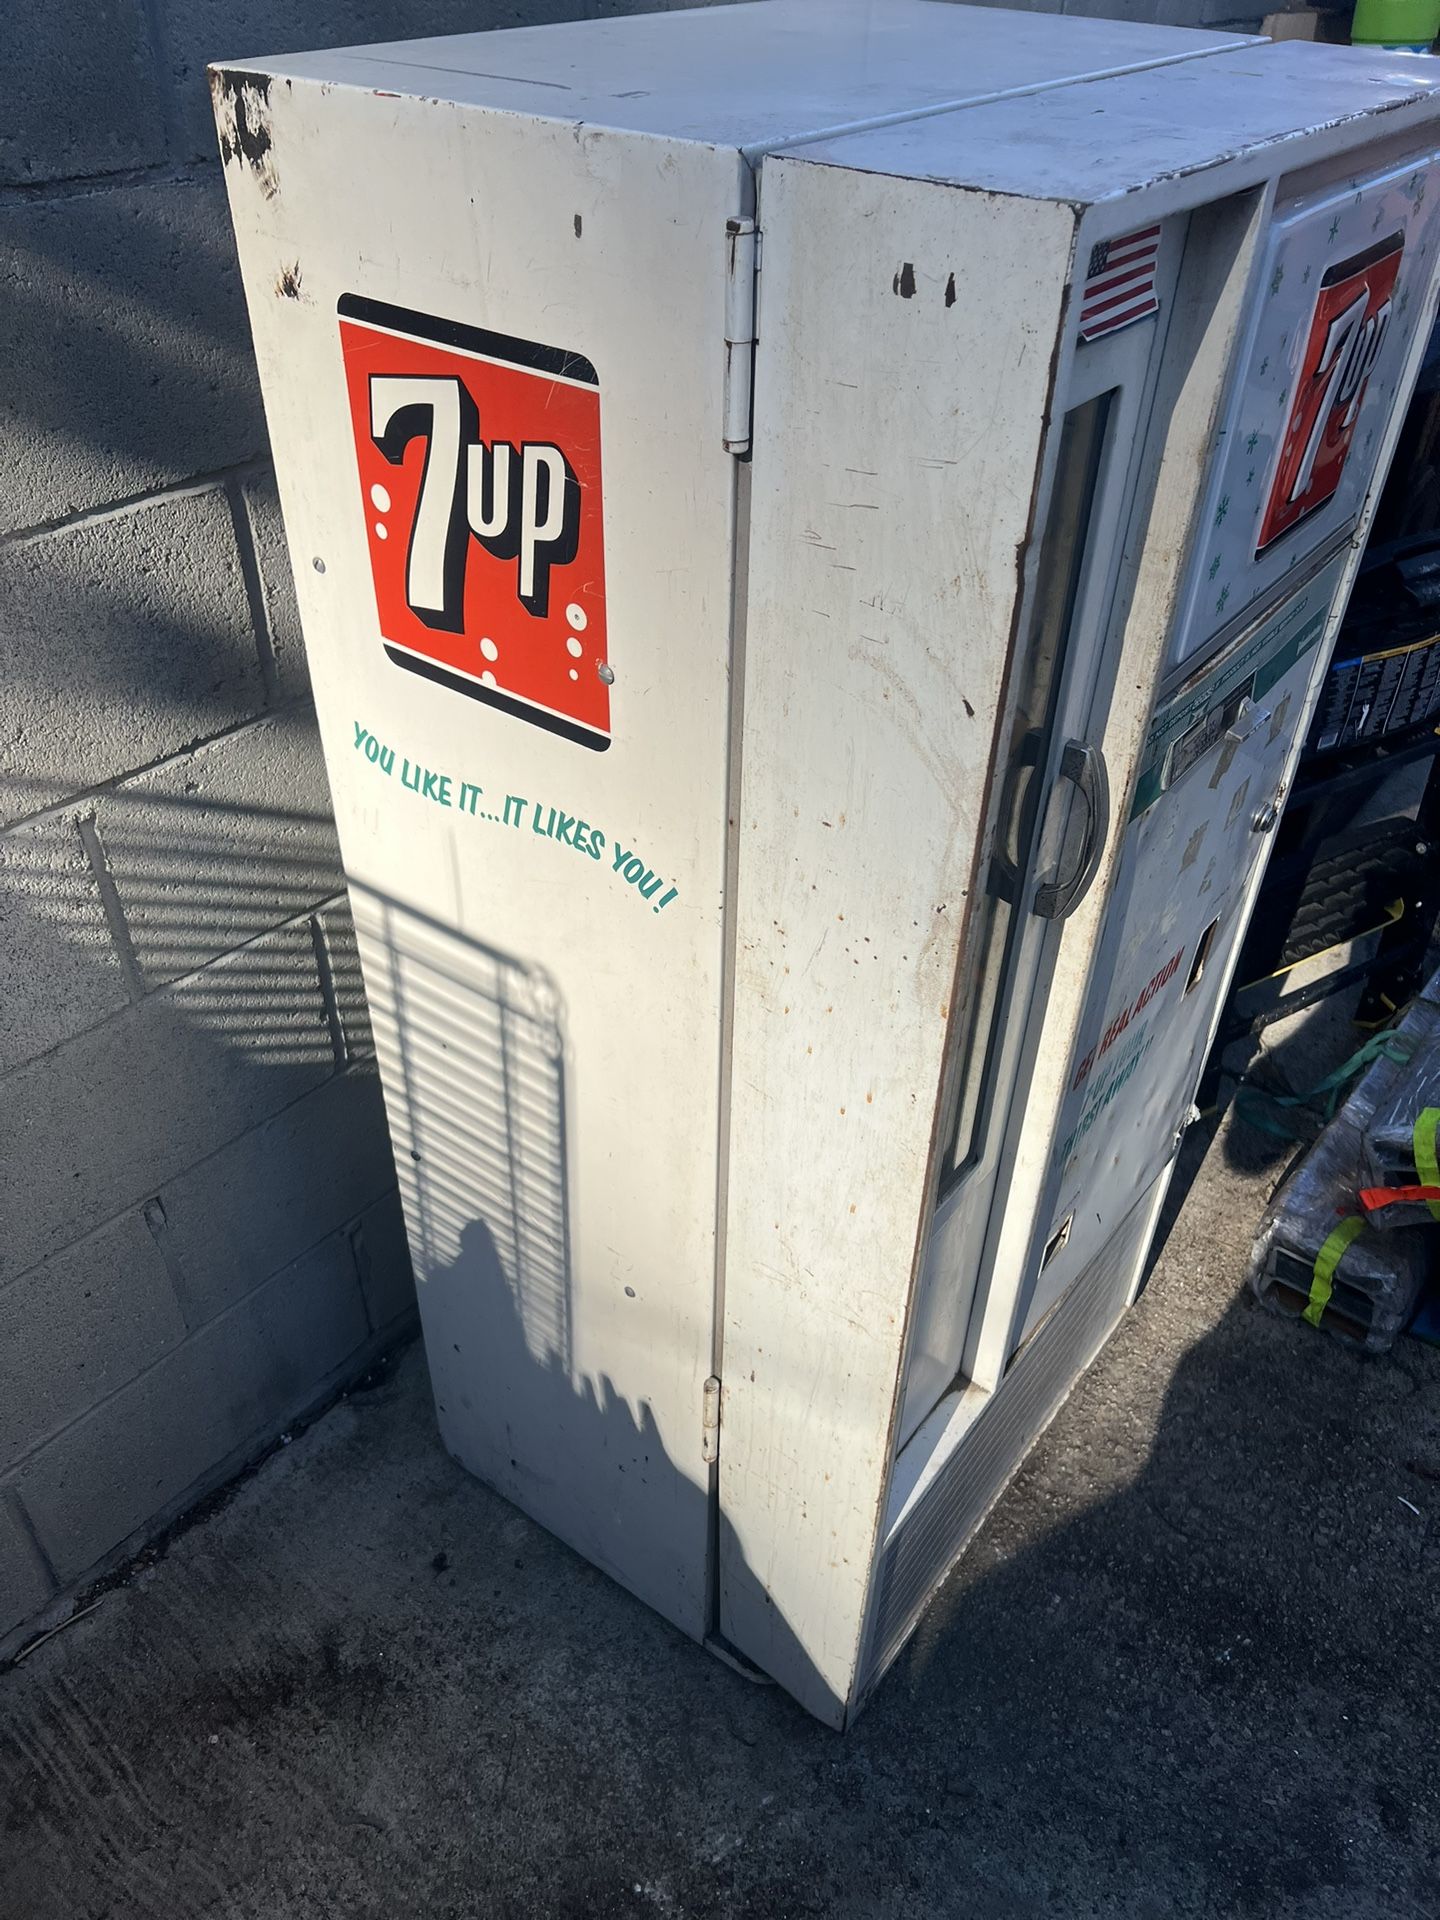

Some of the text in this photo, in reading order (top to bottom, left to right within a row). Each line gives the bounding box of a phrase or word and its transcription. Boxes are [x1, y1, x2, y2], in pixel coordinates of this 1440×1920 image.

[353, 720, 396, 777] YOU
[401, 758, 452, 807] LIKE
[532, 803, 606, 860] LIKES
[612, 841, 679, 914] YOU!
[1072, 945, 1185, 1092] GET REAL ACTION
